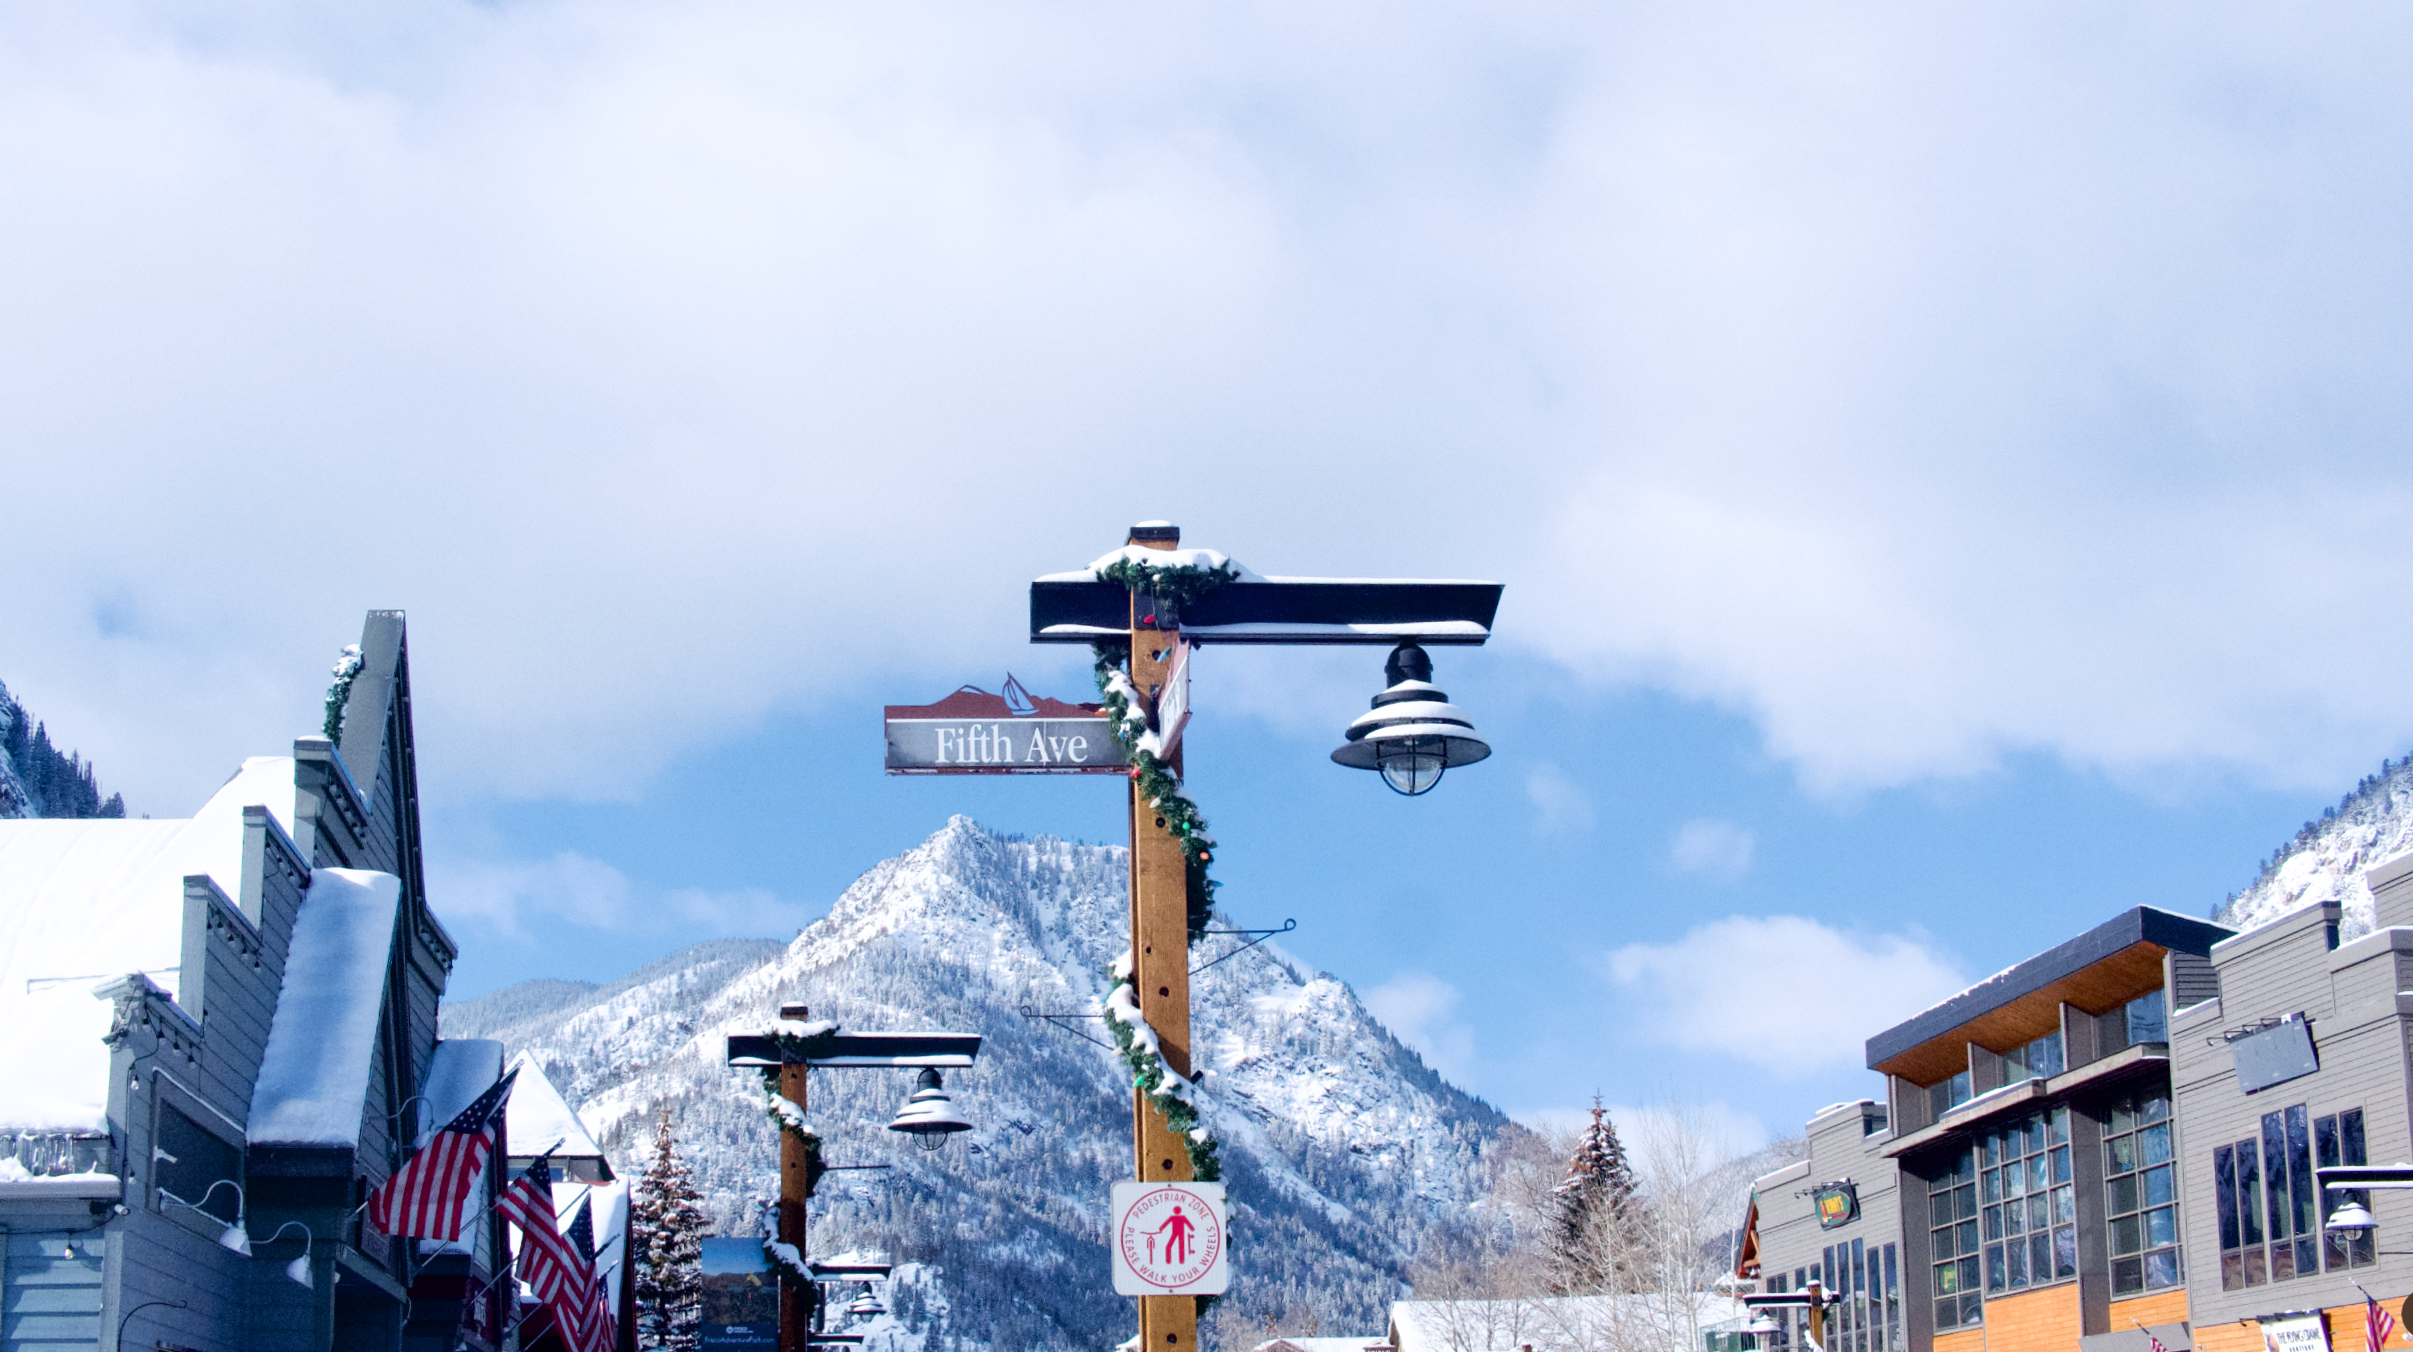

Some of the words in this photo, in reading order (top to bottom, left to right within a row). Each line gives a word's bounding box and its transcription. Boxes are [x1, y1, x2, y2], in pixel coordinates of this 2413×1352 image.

[934, 724, 1015, 763] Fifth
[1024, 727, 1088, 763] Ave
[1132, 1192, 1187, 1219] PEDESTRIAN
[1188, 1198, 1210, 1220] ZONE
[1125, 1226, 1140, 1265] PLEASE
[1139, 1264, 1167, 1283] WALK
[1171, 1266, 1200, 1283] YOUR
[1199, 1226, 1216, 1266] WHEELS
[2276, 1332, 2288, 1344] THE
